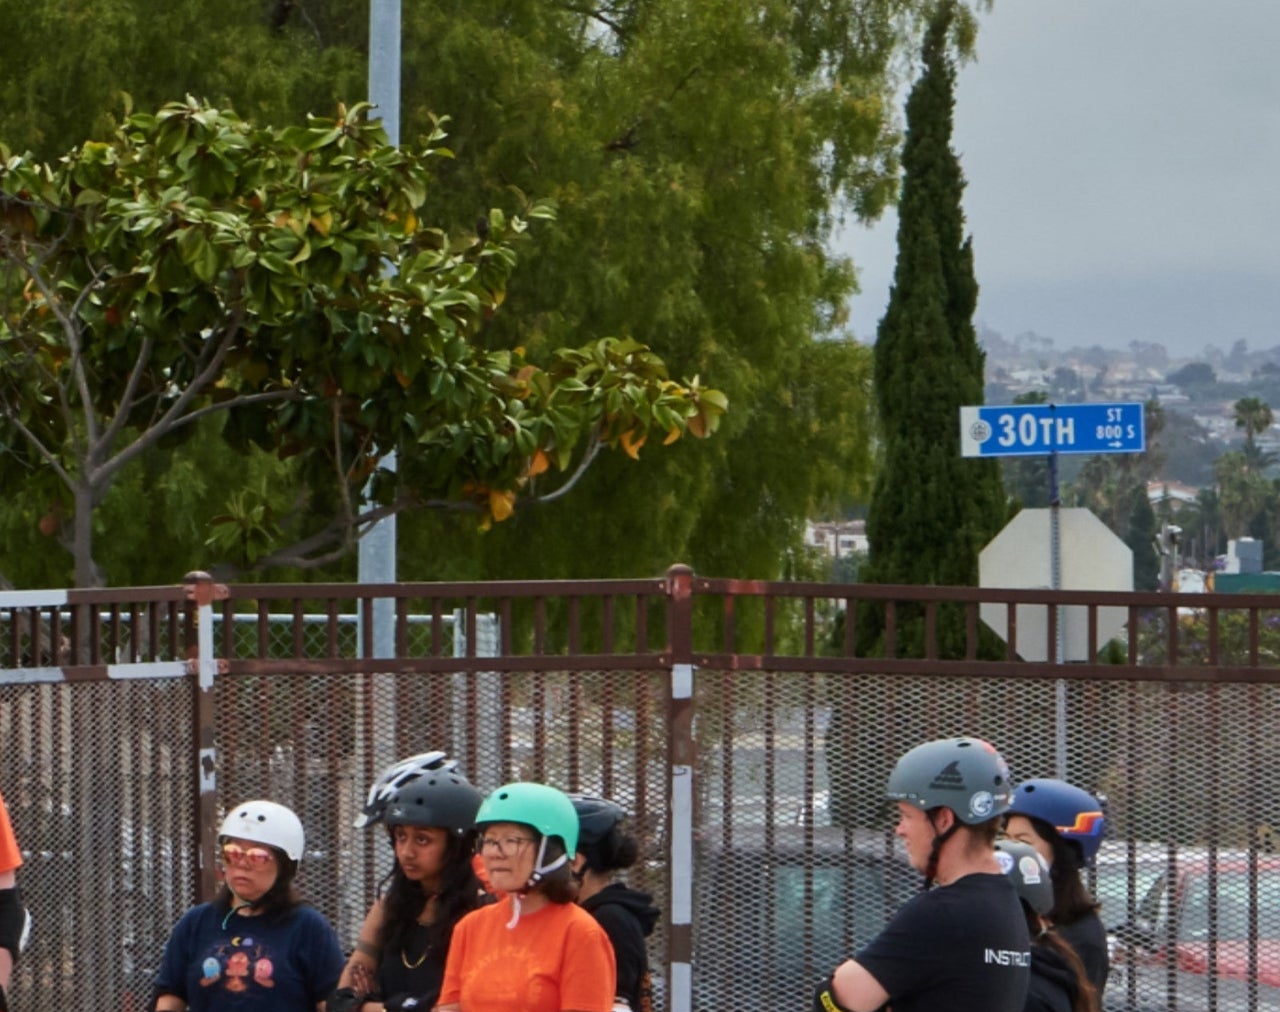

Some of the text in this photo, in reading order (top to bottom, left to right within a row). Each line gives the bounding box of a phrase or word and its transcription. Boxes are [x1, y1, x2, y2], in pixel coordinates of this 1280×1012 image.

[1107, 408, 1123, 422] ST
[998, 414, 1075, 447] 30TH
[1096, 425, 1135, 440] 800 S
